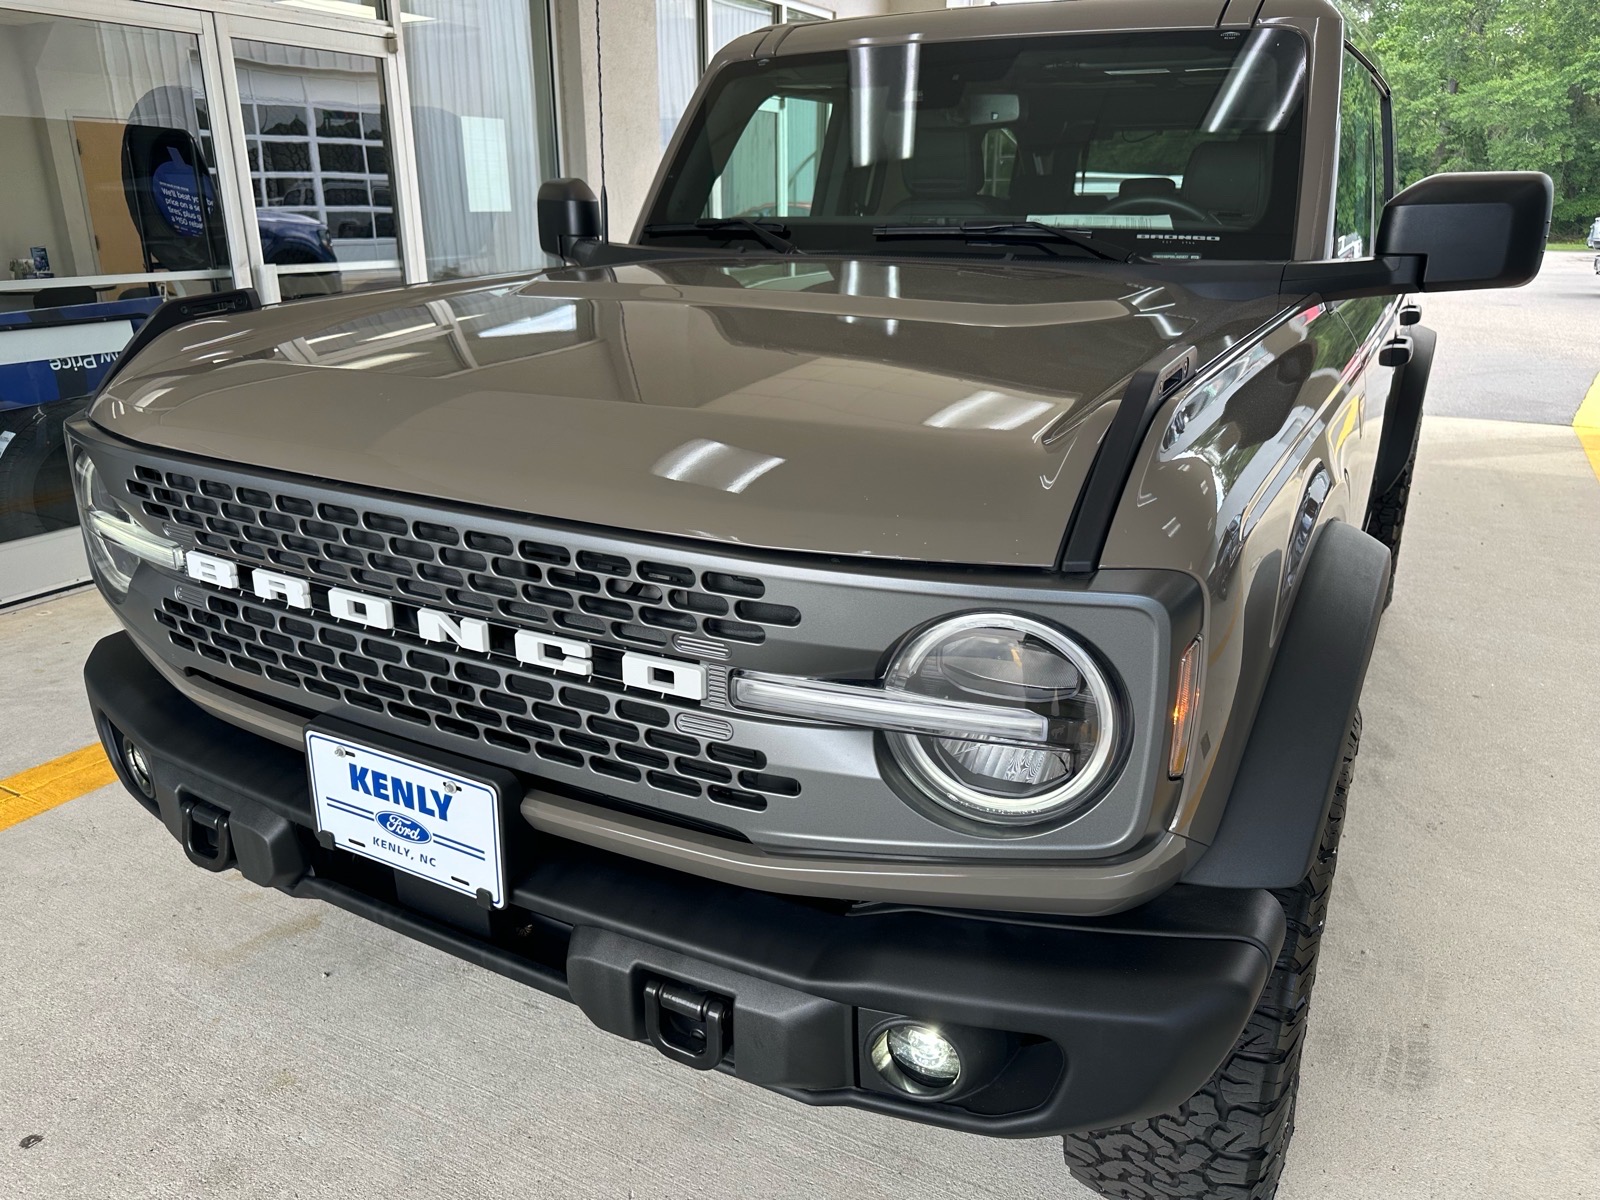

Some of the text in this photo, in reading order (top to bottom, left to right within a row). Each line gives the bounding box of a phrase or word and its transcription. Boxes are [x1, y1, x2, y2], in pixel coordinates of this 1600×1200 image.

[49, 354, 97, 371] Price
[185, 549, 708, 700] BRONCO
[348, 762, 453, 822] KENLY
[386, 814, 420, 842] Ford
[372, 835, 437, 867] KENLY, NC
